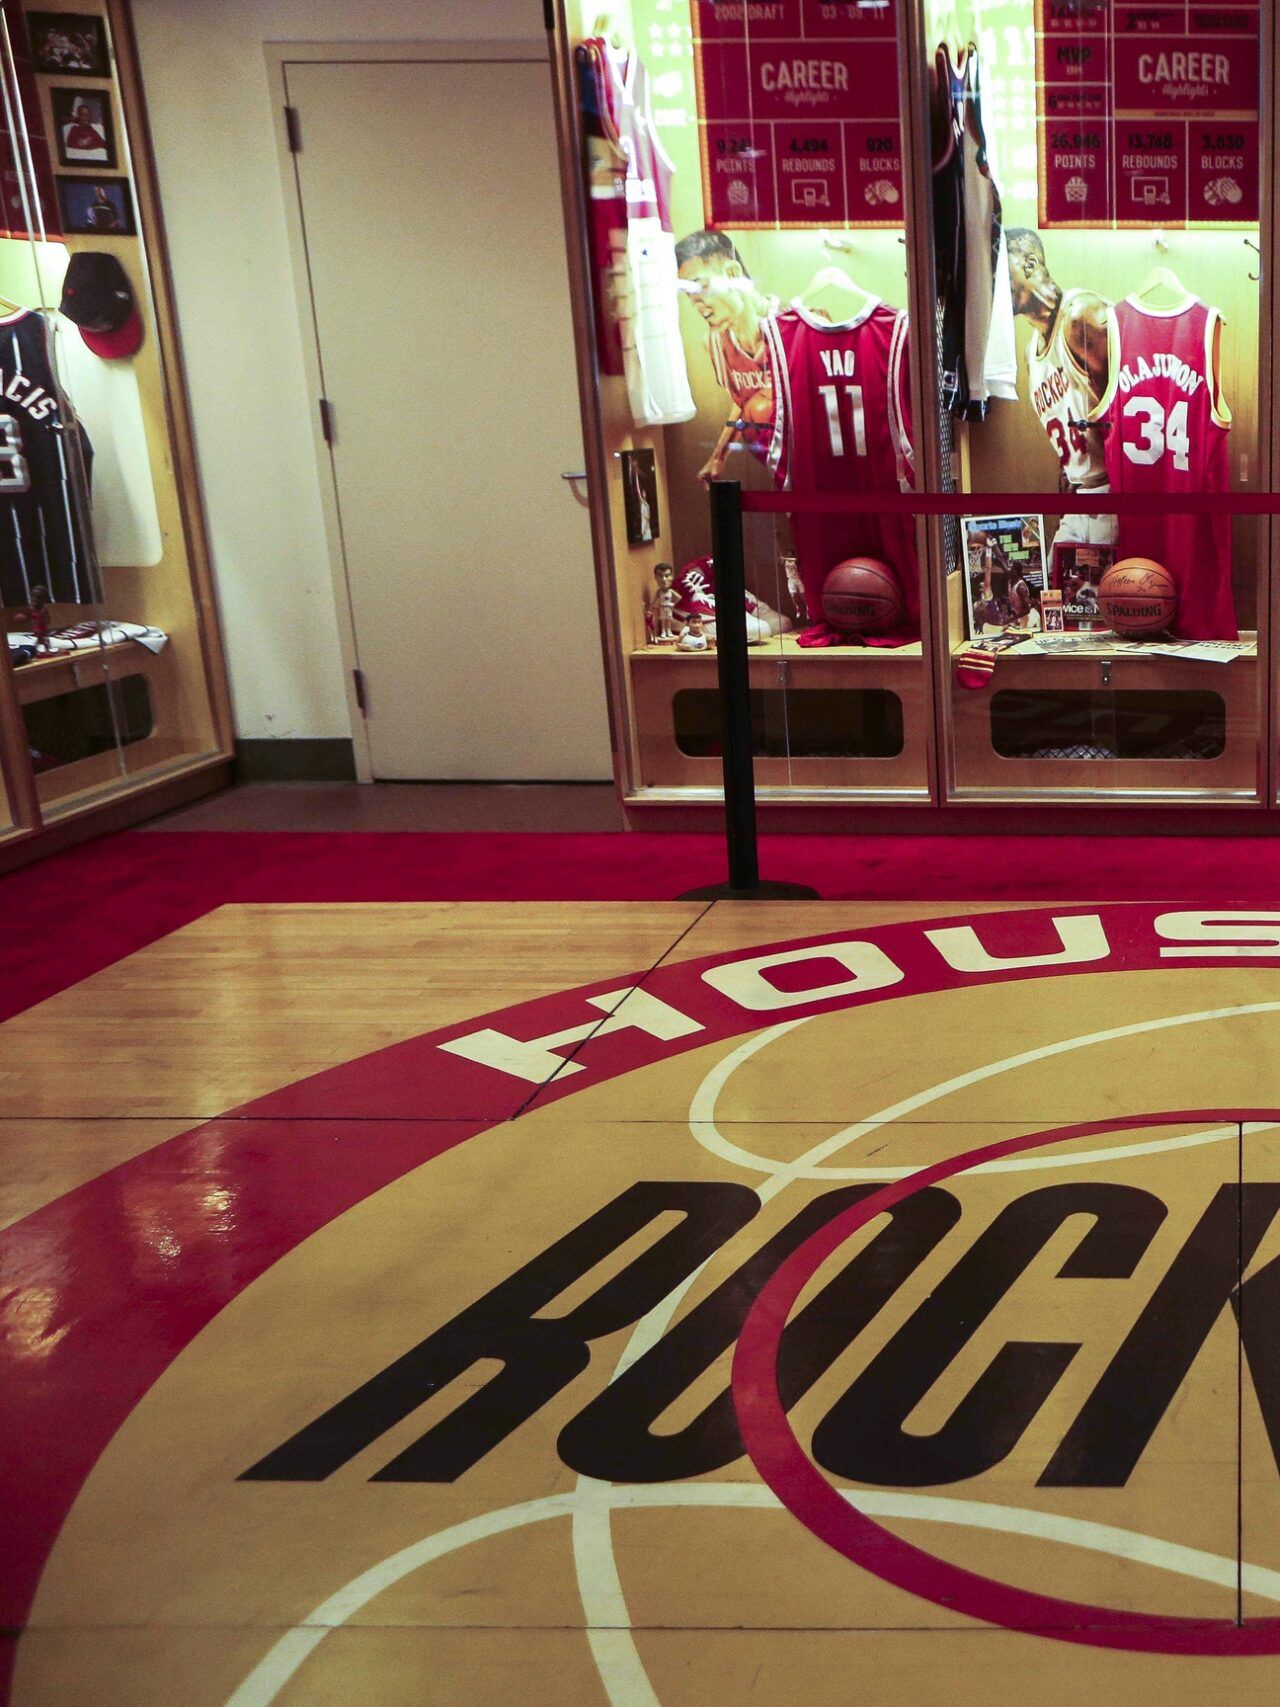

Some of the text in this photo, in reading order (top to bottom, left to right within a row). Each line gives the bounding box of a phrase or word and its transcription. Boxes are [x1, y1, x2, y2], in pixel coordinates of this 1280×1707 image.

[760, 58, 850, 92] CAREER
[1138, 52, 1230, 85] CAREER
[716, 157, 754, 173] POINTS
[781, 157, 835, 173] REBOUNDS
[858, 157, 900, 173] BLOCKS
[1055, 153, 1096, 169] POINTS
[1122, 154, 1178, 169] REBOUNDS
[1201, 155, 1244, 169] BLOCKS
[819, 349, 855, 377] YAO
[731, 369, 772, 391] ROCKE
[818, 384, 867, 456] 11
[1046, 406, 1089, 466] 34
[1122, 396, 1190, 471] 34
[1061, 602, 1085, 614] wice
[1106, 602, 1163, 618] SPALDING
